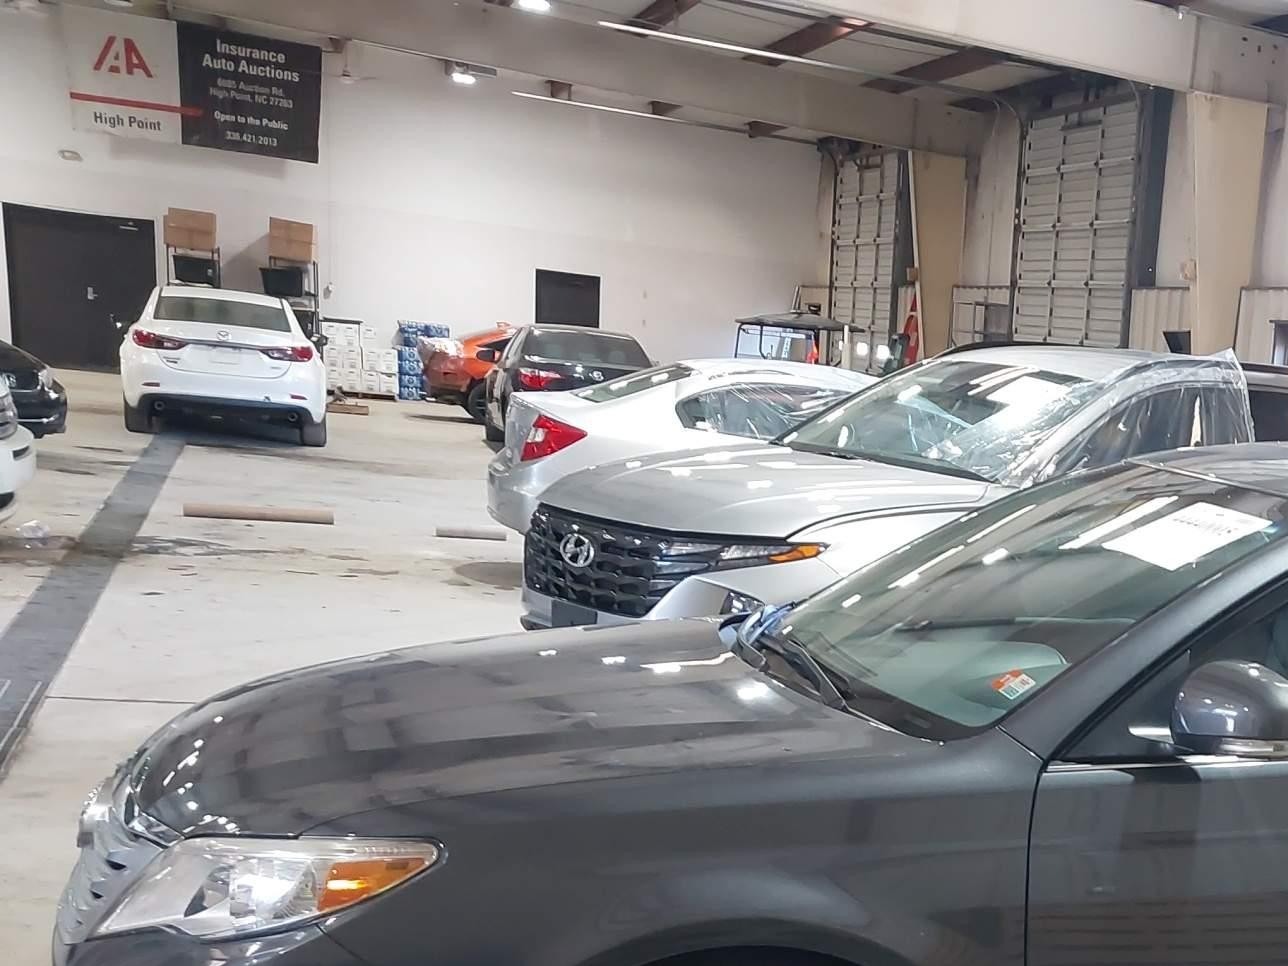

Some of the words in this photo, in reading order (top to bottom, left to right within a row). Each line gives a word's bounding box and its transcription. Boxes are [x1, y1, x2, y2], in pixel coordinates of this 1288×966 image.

[216, 38, 286, 64] Insurance
[202, 53, 235, 72] Auto
[238, 59, 300, 82] Auctions
[254, 95, 268, 104] NC
[93, 111, 125, 131] High
[128, 115, 162, 132] Point
[214, 110, 236, 122] Open
[237, 115, 246, 124] to
[247, 116, 260, 126] the
[262, 118, 289, 131] Public
